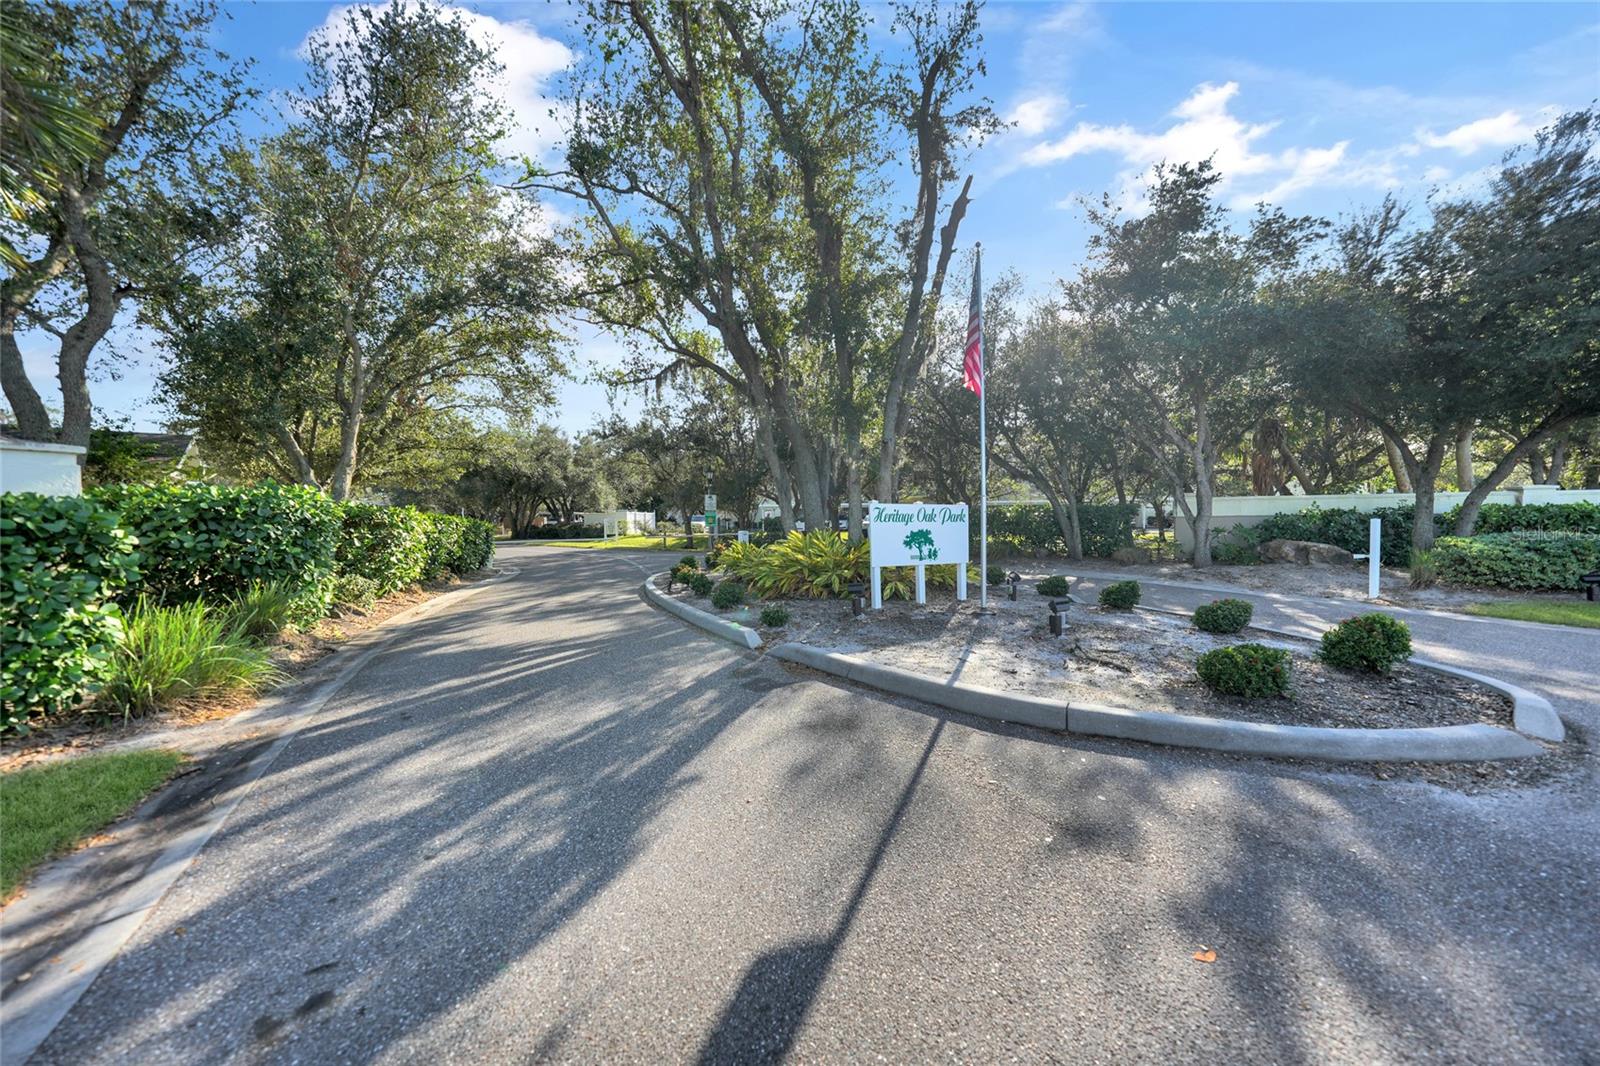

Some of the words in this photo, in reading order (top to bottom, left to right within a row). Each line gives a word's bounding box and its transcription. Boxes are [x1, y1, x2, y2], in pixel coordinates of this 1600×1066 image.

[873, 506, 915, 526] Heritage
[917, 507, 937, 523] Oak
[939, 507, 966, 526] Park
